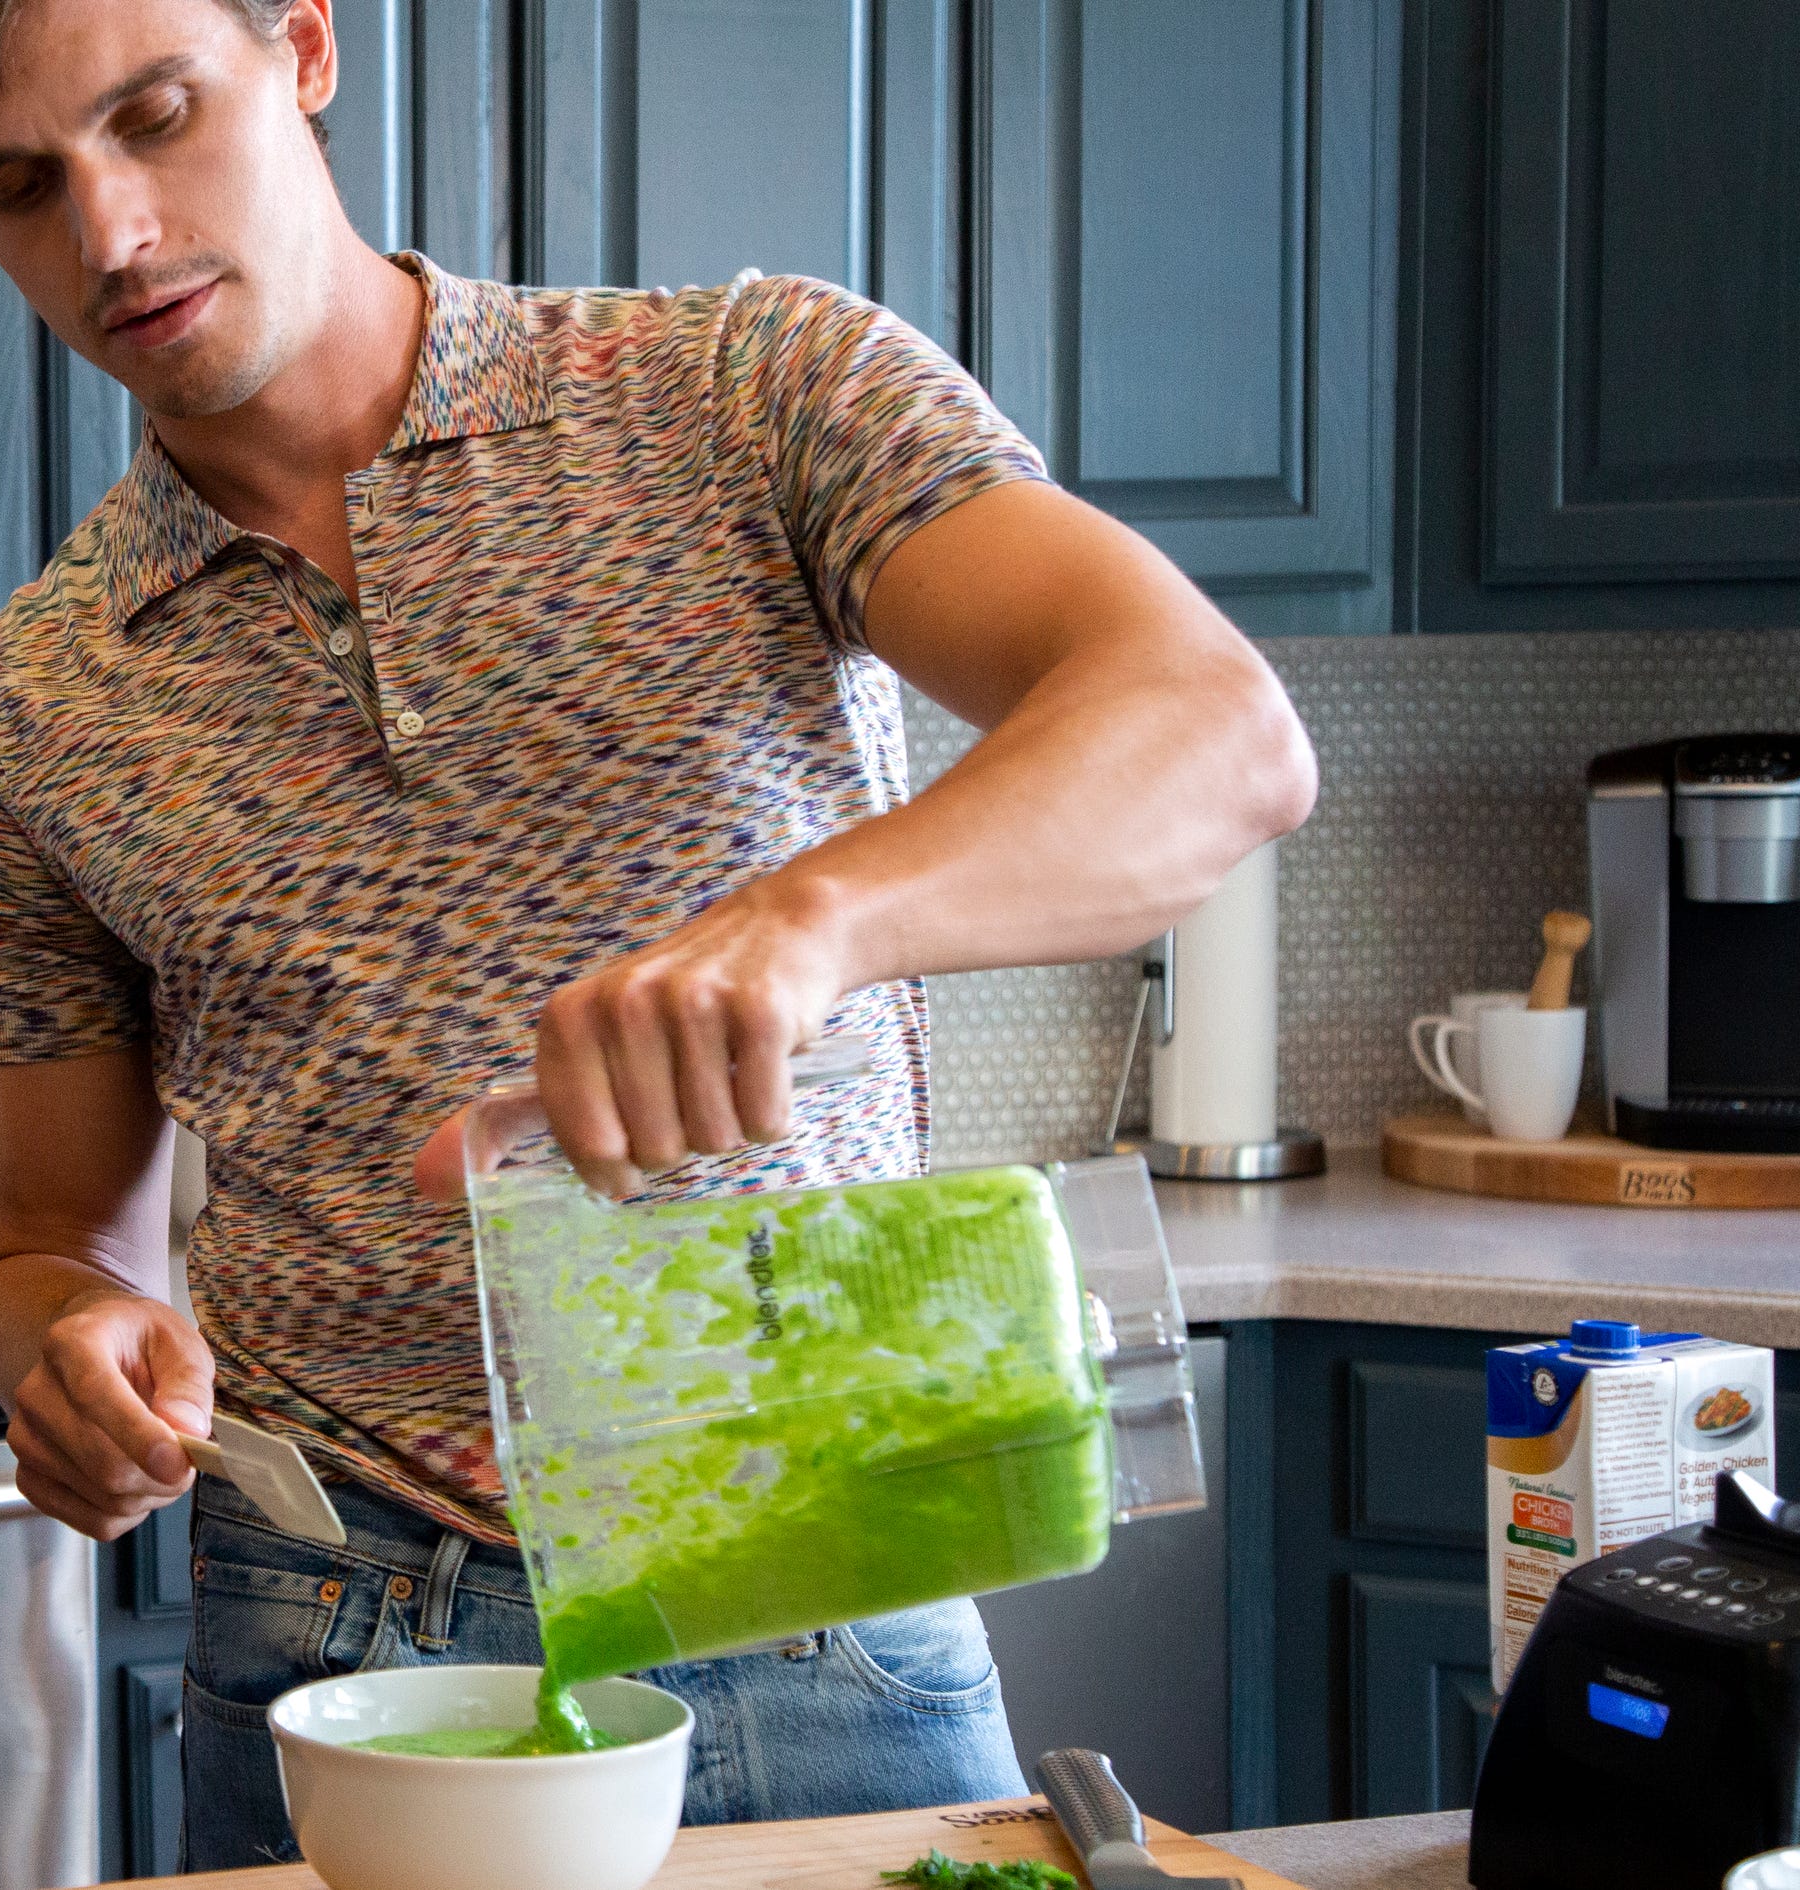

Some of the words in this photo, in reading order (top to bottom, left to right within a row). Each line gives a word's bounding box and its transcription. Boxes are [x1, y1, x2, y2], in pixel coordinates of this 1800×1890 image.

[746, 1223, 783, 1341] blendtec
[1679, 1462, 1718, 1475] Golden
[1722, 1456, 1769, 1470] Chicken
[1518, 1497, 1572, 1520] CHICKEN
[1531, 1514, 1561, 1530] BROTH
[1600, 1530, 1614, 1540] DO
[1616, 1527, 1634, 1537] NOT
[1636, 1523, 1667, 1535] DILUTE
[1507, 1558, 1551, 1577] Nutrition
[1605, 1666, 1663, 1695] blendtec
